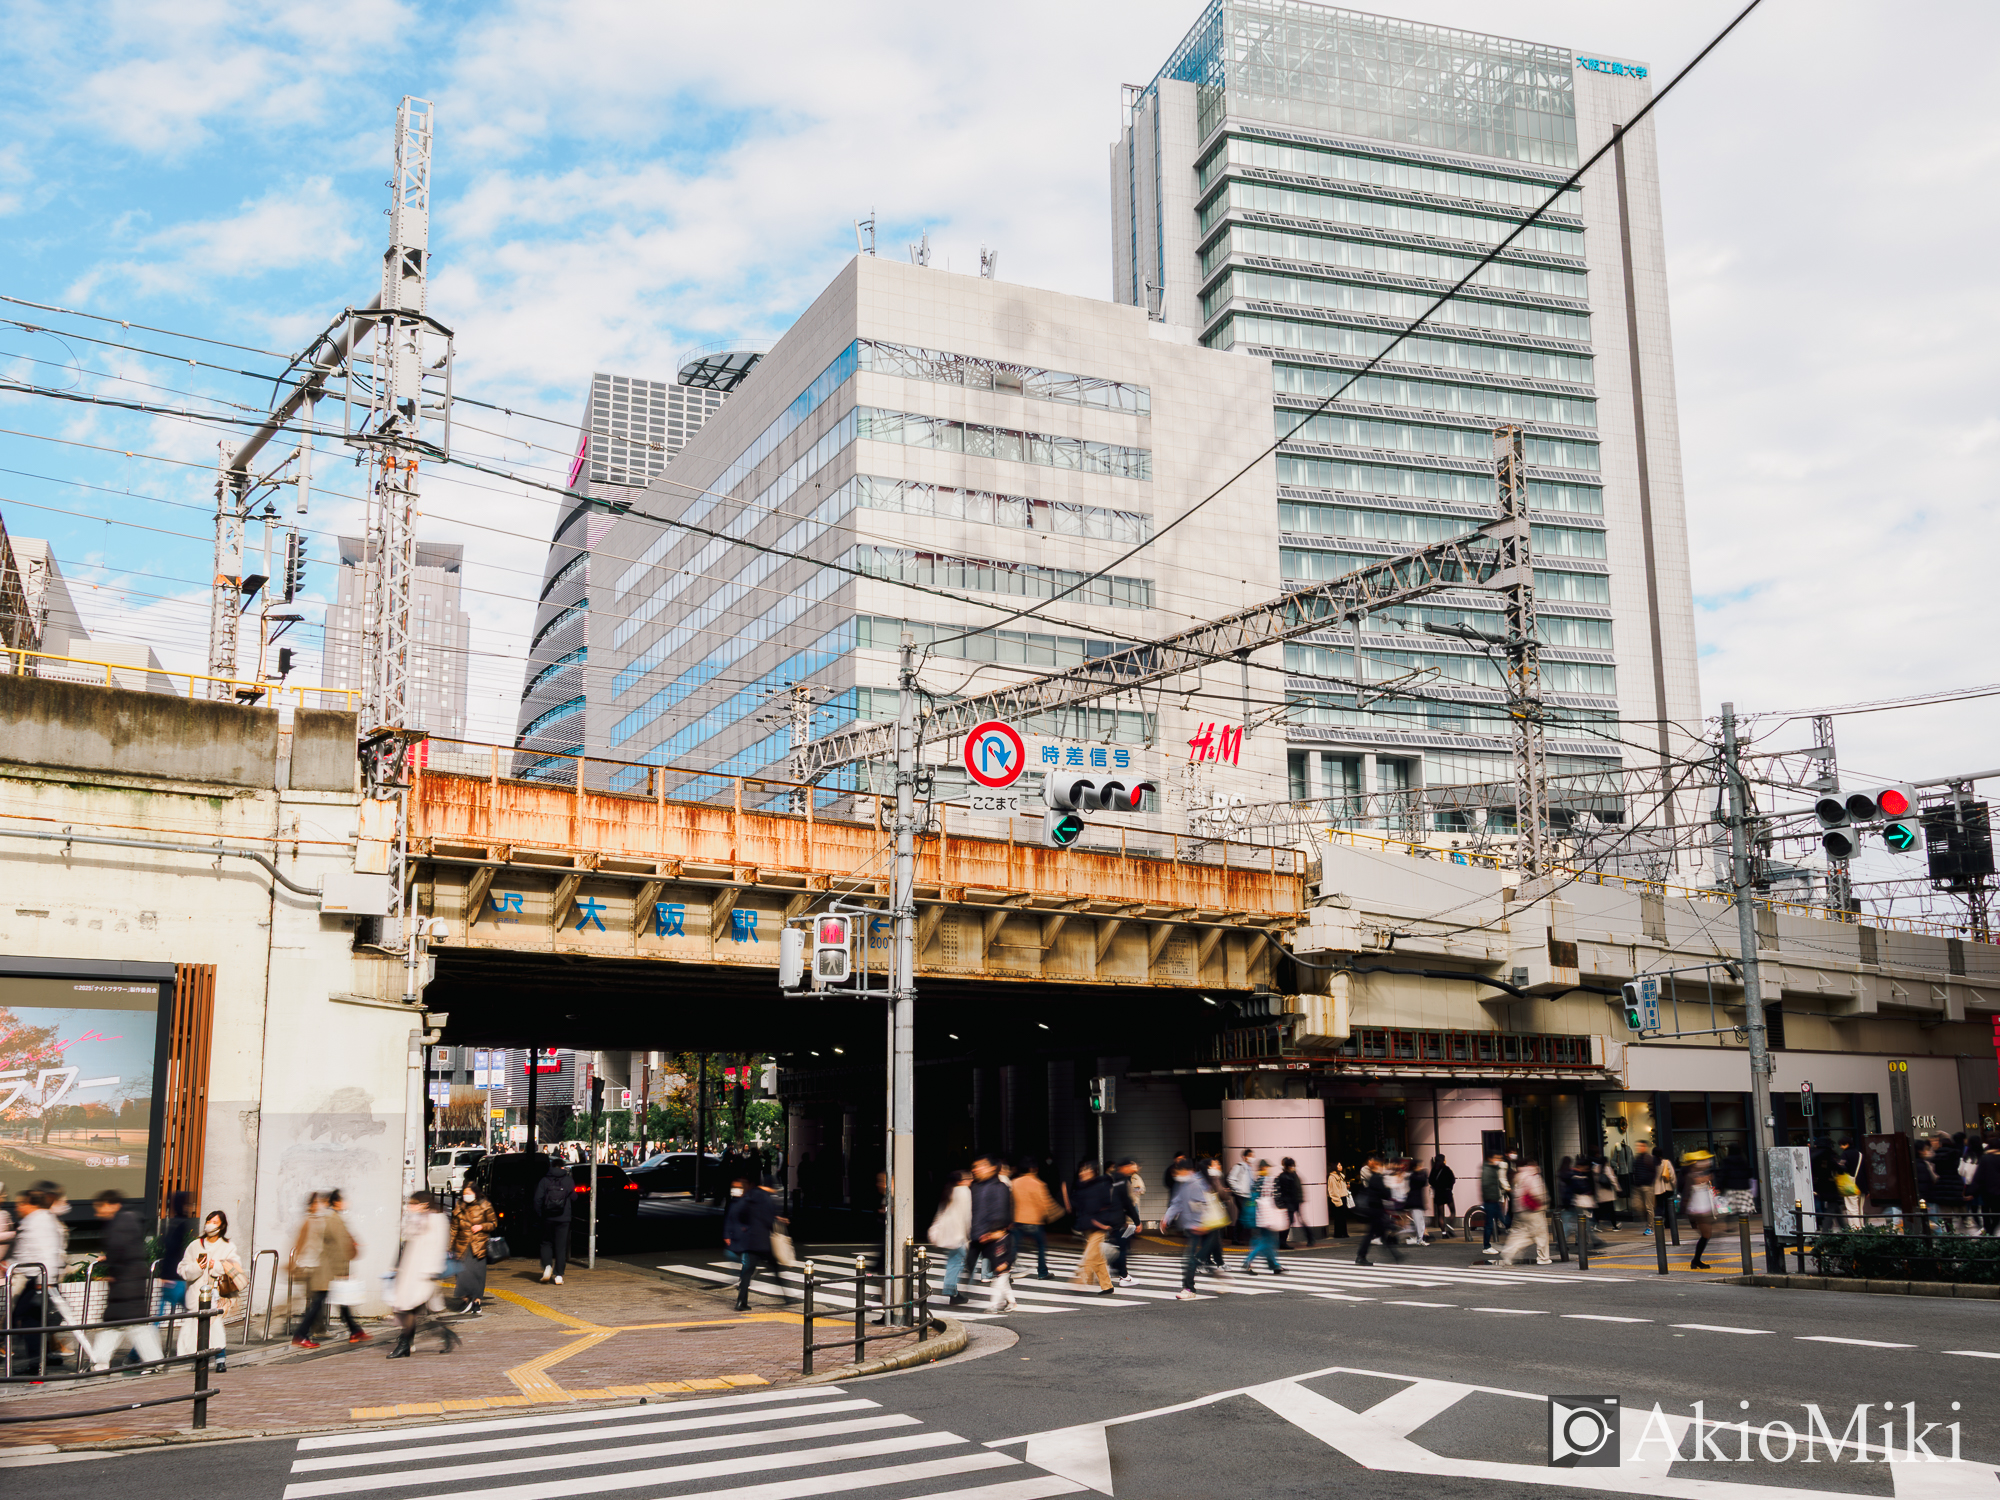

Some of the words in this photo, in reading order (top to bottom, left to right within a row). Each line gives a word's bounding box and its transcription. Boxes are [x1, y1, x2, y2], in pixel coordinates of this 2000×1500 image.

[1576, 56, 1648, 79] 大阪工業大学
[1188, 722, 1243, 767] H&M
[1041, 745, 1131, 768] 時差信号
[972, 796, 1018, 811] ここまで
[491, 892, 524, 914] JR
[575, 896, 760, 944] 大阪駅
